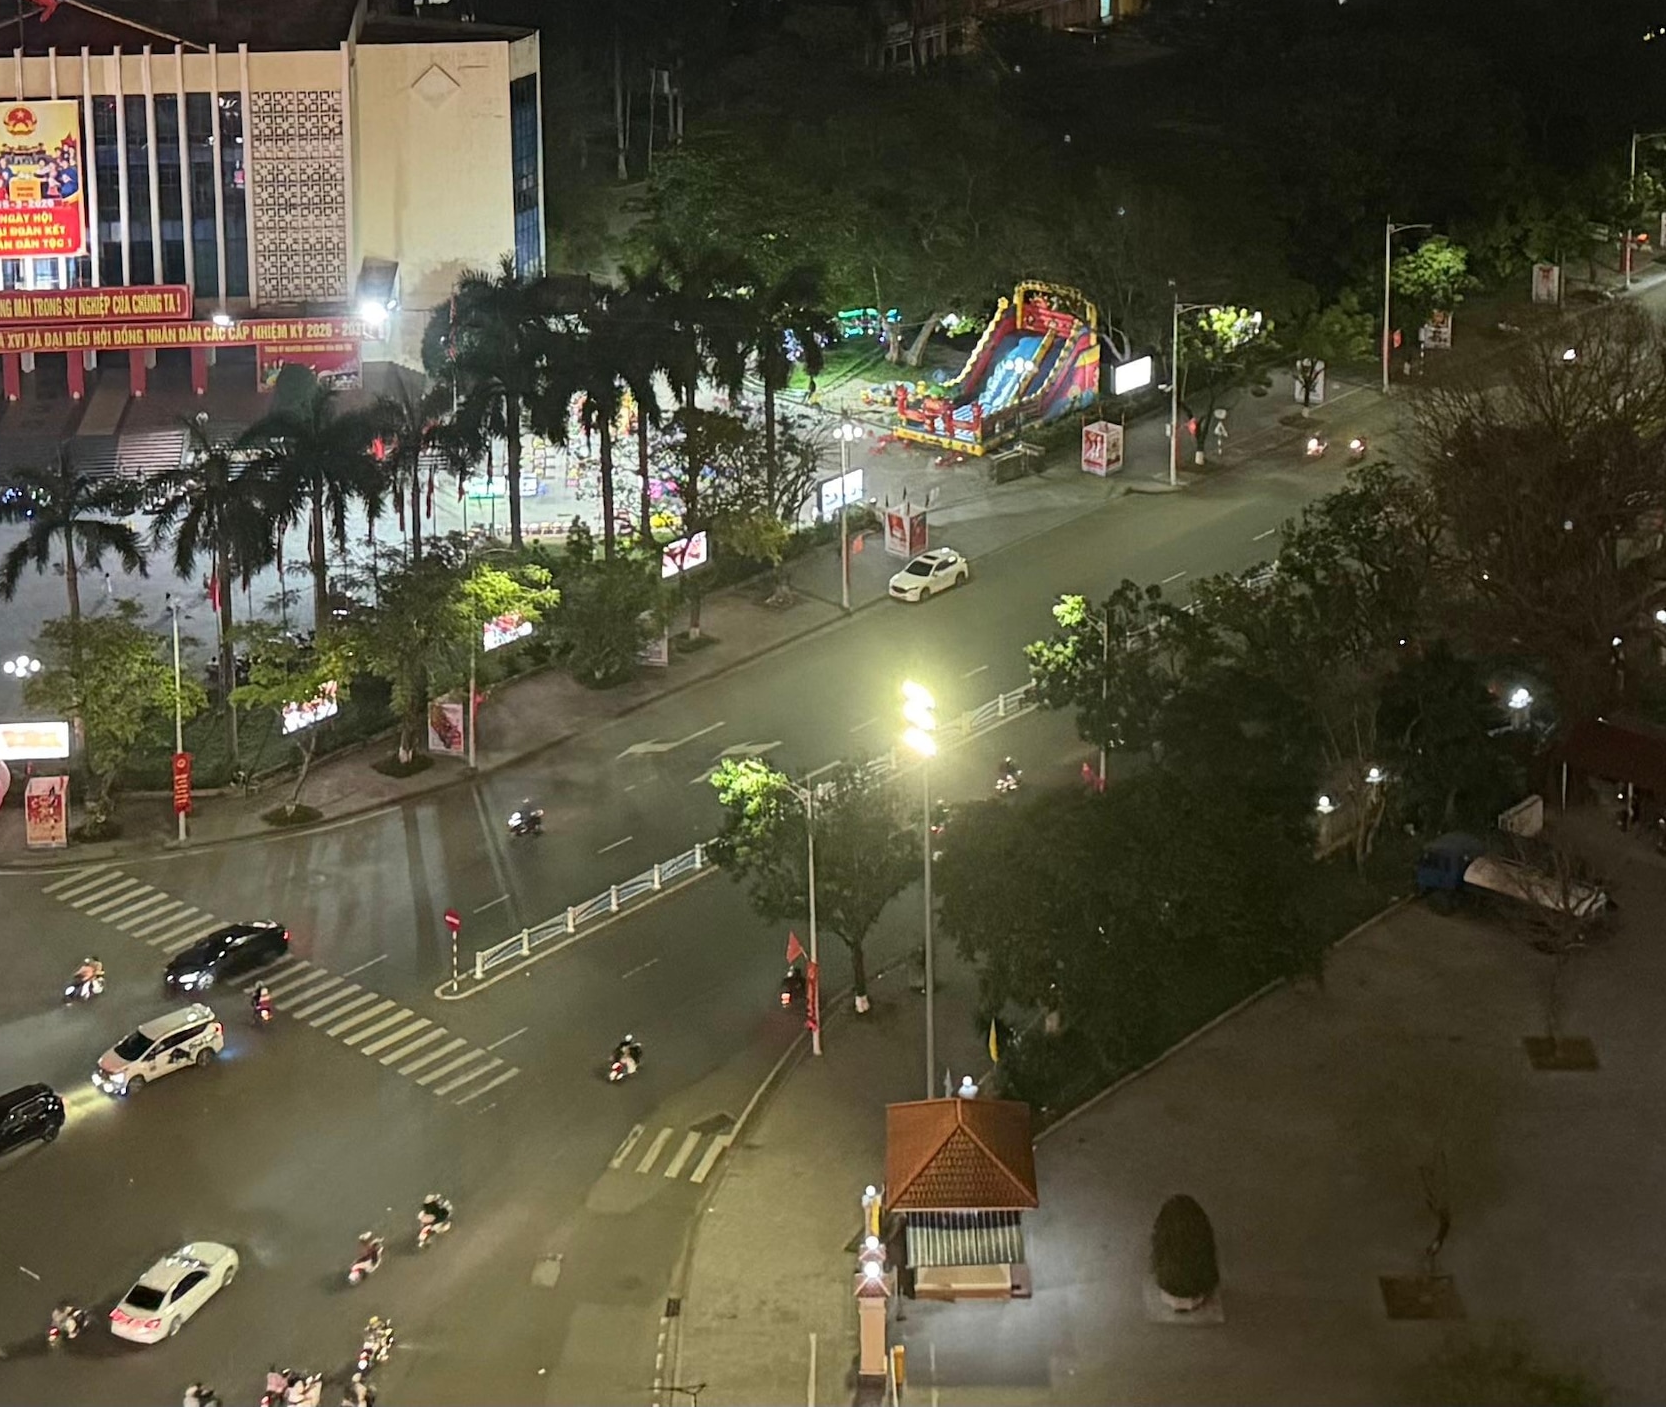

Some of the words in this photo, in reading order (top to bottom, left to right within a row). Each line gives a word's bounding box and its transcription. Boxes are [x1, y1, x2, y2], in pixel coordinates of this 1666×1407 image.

[0, 212, 30, 223] NGÀY
[33, 211, 53, 223] HỘI
[9, 224, 42, 237] ĐOÀN
[44, 223, 65, 235] KẾT
[15, 237, 40, 249] DÂN
[42, 237, 64, 250] TỘC
[32, 296, 62, 317] TRONG
[63, 296, 76, 318] SỰ
[78, 293, 110, 318] NGHIỆP
[112, 290, 131, 314] CỦA
[132, 290, 162, 314] CHÚNG
[163, 293, 175, 313] TA
[8, 333, 25, 349] XVI
[27, 329, 42, 349] VÀ
[44, 331, 63, 350] ĐẠI
[93, 327, 112, 348] HỘI
[113, 325, 144, 345] ĐỒNG
[146, 324, 176, 344] NHÂN
[179, 323, 202, 343] DÂN
[204, 323, 226, 342] CÁC
[228, 320, 250, 341] CẤP
[252, 321, 288, 343] NHIỆM
[290, 320, 304, 339] KỲ
